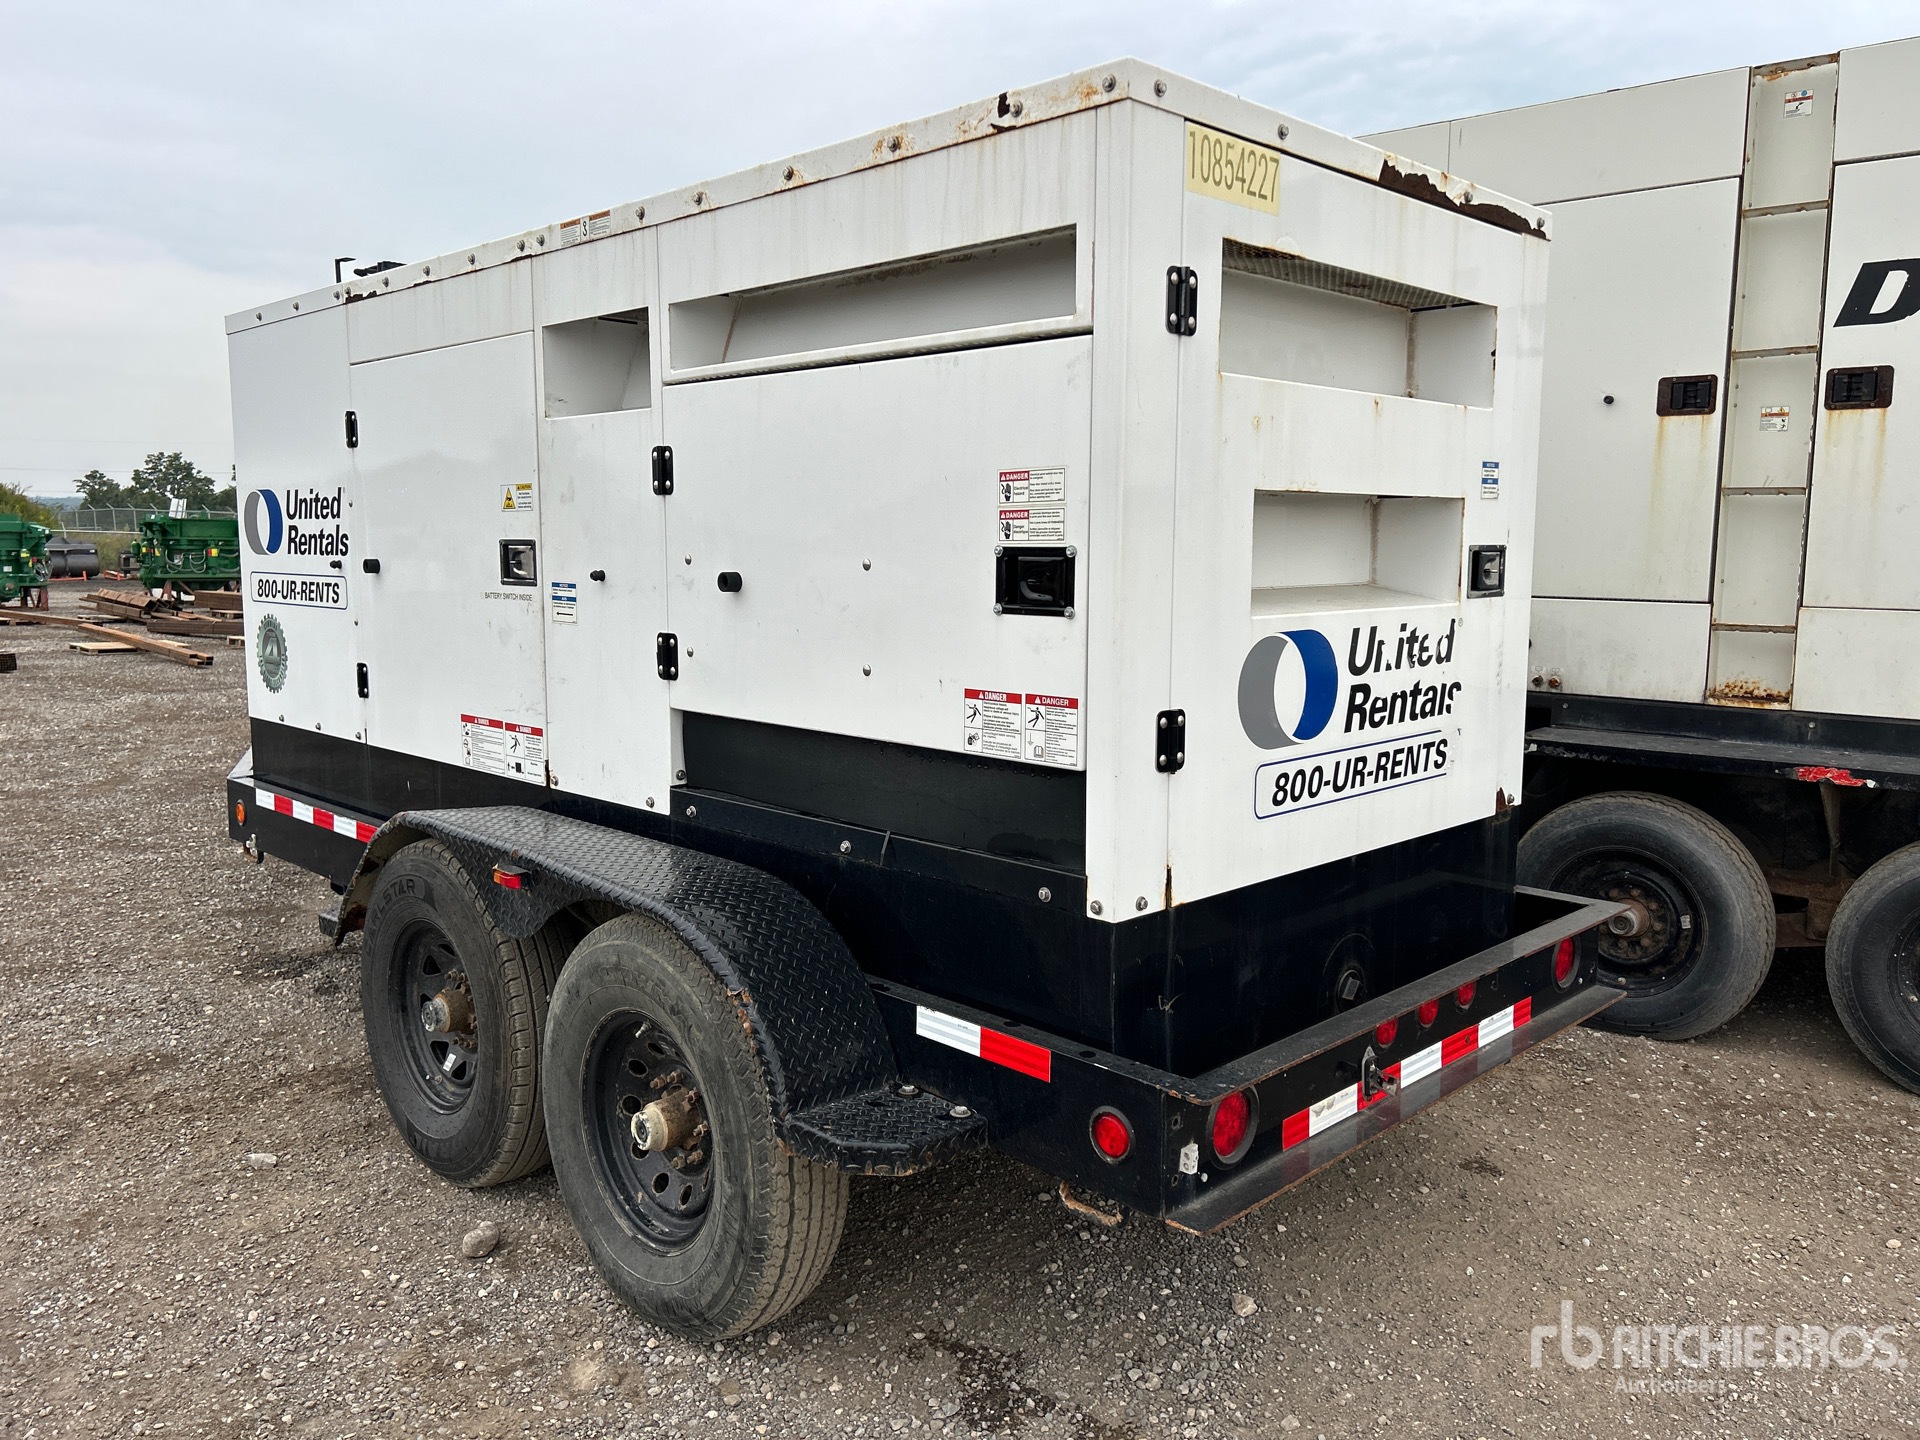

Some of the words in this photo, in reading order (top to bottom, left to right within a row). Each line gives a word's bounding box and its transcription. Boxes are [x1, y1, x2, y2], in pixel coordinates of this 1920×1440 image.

[1189, 131, 1280, 203] 10854227
[1005, 472, 1029, 481] DANGER
[286, 486, 342, 521] United
[1005, 511, 1029, 519] DANGER
[287, 524, 349, 557] Rentals
[257, 578, 340, 604] 800-UR-RENTS
[484, 591, 502, 600] BATTERY
[502, 592, 519, 600] SWITCH
[519, 593, 533, 602] INSIDE
[984, 692, 1007, 702] DANGER
[1042, 697, 1070, 707] DANGER
[1343, 680, 1462, 734] Rentals
[1271, 738, 1448, 807] 800-UR-RENTS
